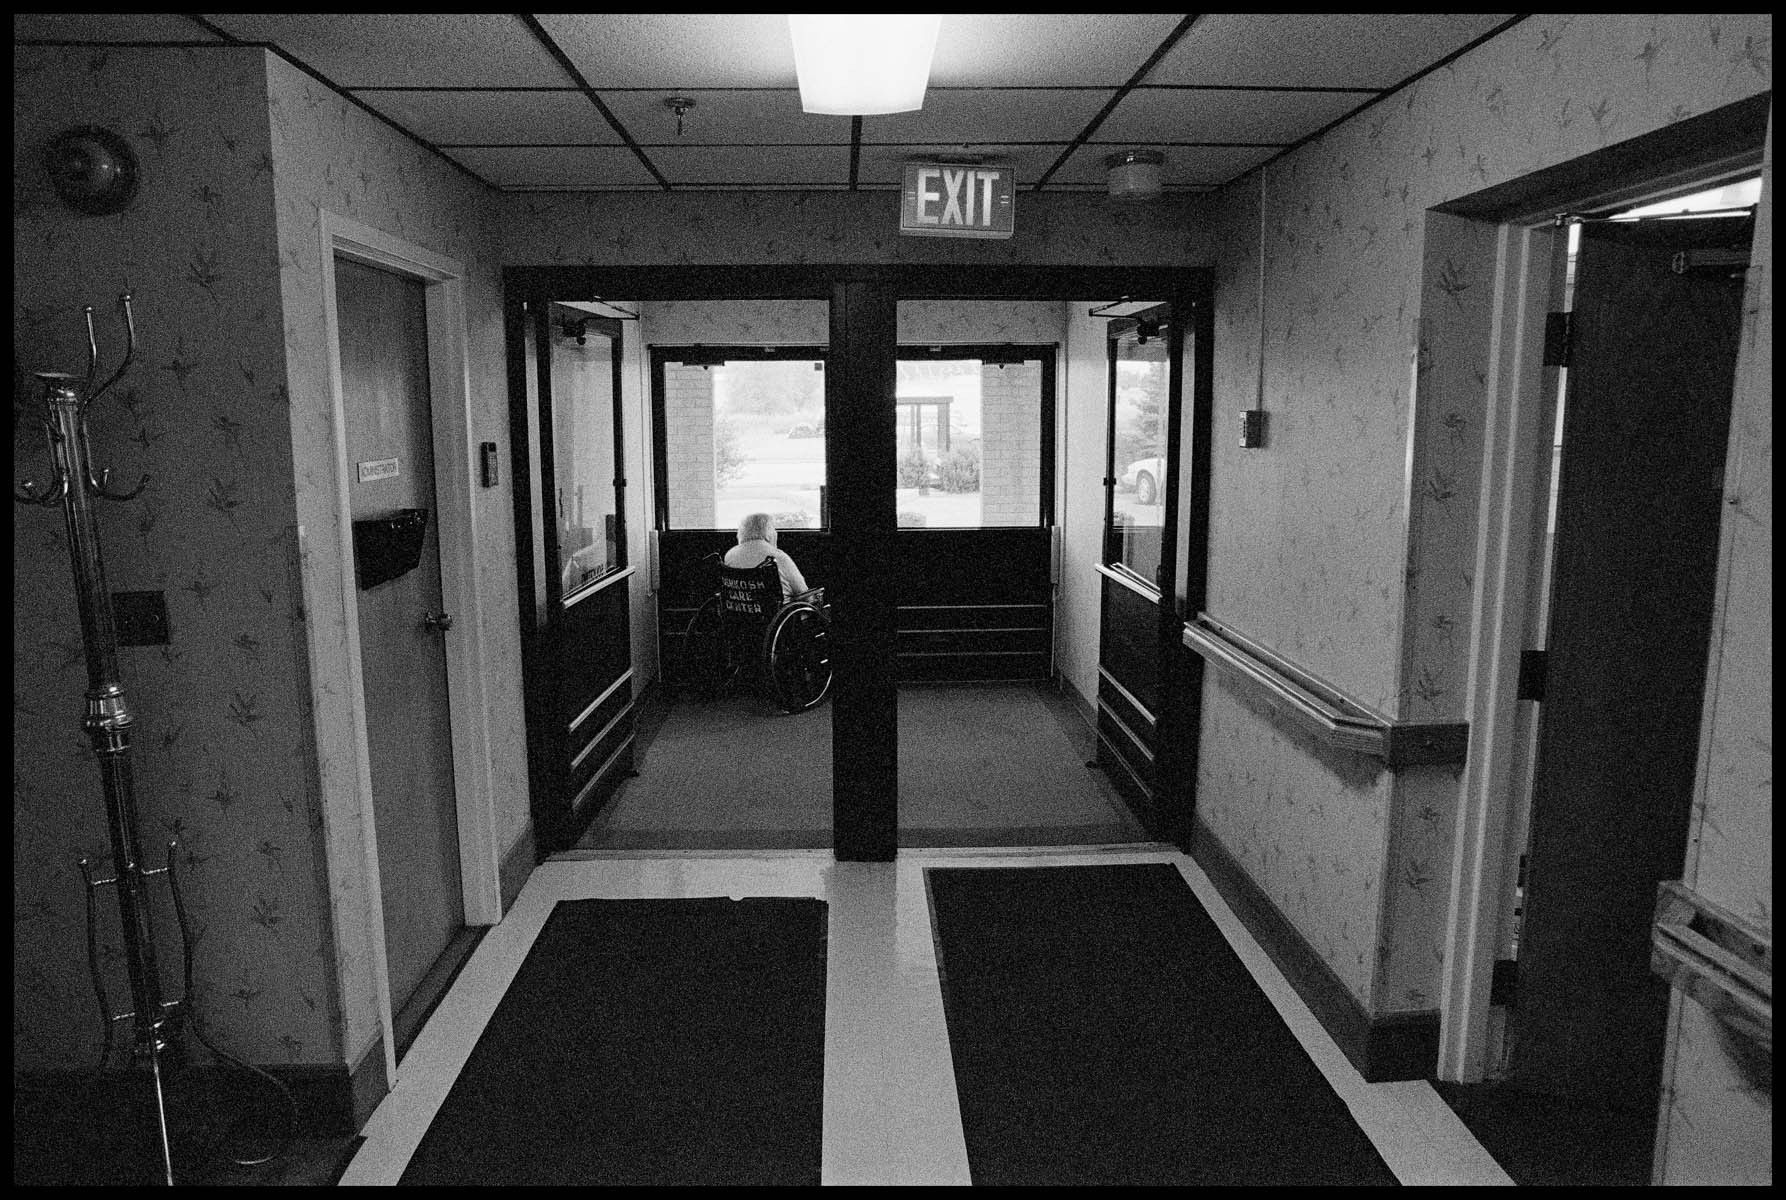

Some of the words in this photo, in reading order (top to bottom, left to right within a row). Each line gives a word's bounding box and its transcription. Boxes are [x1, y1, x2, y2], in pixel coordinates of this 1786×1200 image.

[917, 168, 1000, 227] EXIT
[728, 590, 753, 602] CARE
[725, 599, 762, 614] CENTER
